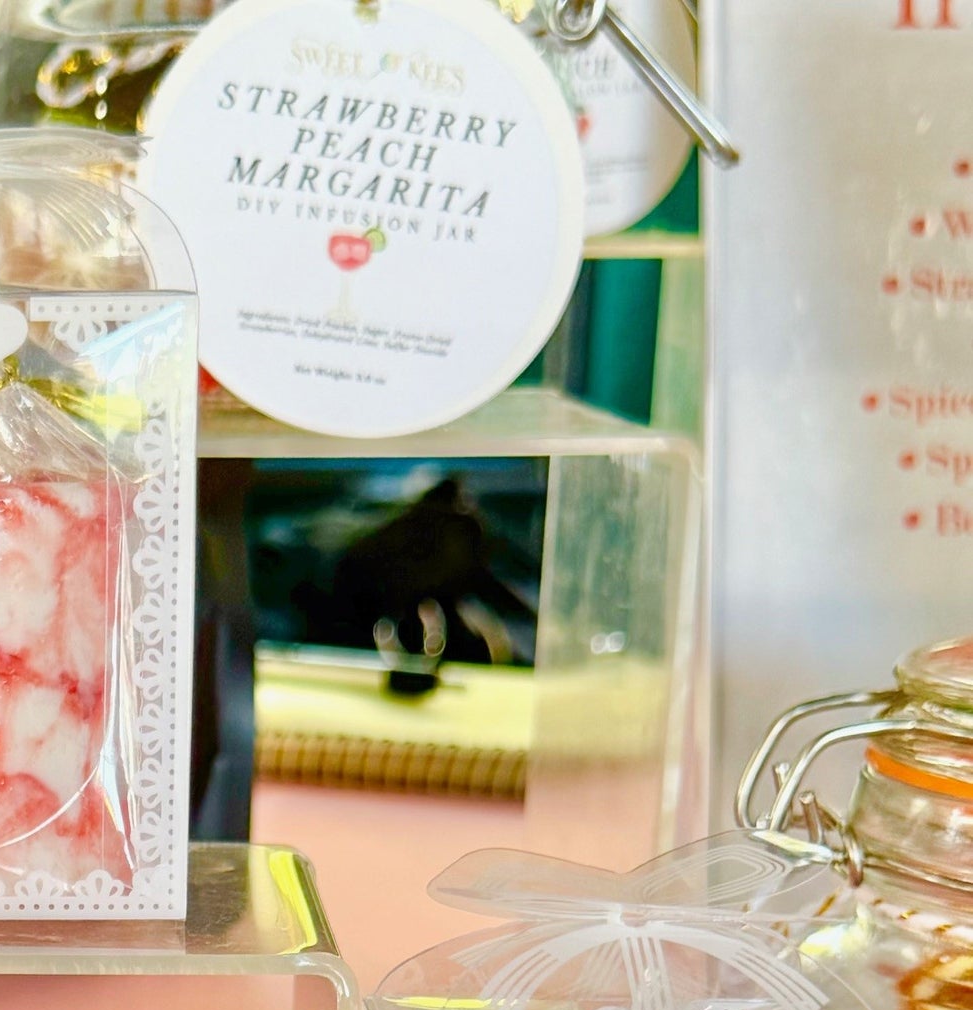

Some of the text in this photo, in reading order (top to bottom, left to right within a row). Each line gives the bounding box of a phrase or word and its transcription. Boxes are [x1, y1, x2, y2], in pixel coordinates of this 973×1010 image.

[218, 82, 517, 148] STRAWBERRY
[291, 127, 438, 174] PEACH
[227, 156, 491, 219] MARGARITA
[236, 196, 478, 243] DIY INFUSION JAR
[888, 385, 973, 425] Spic
